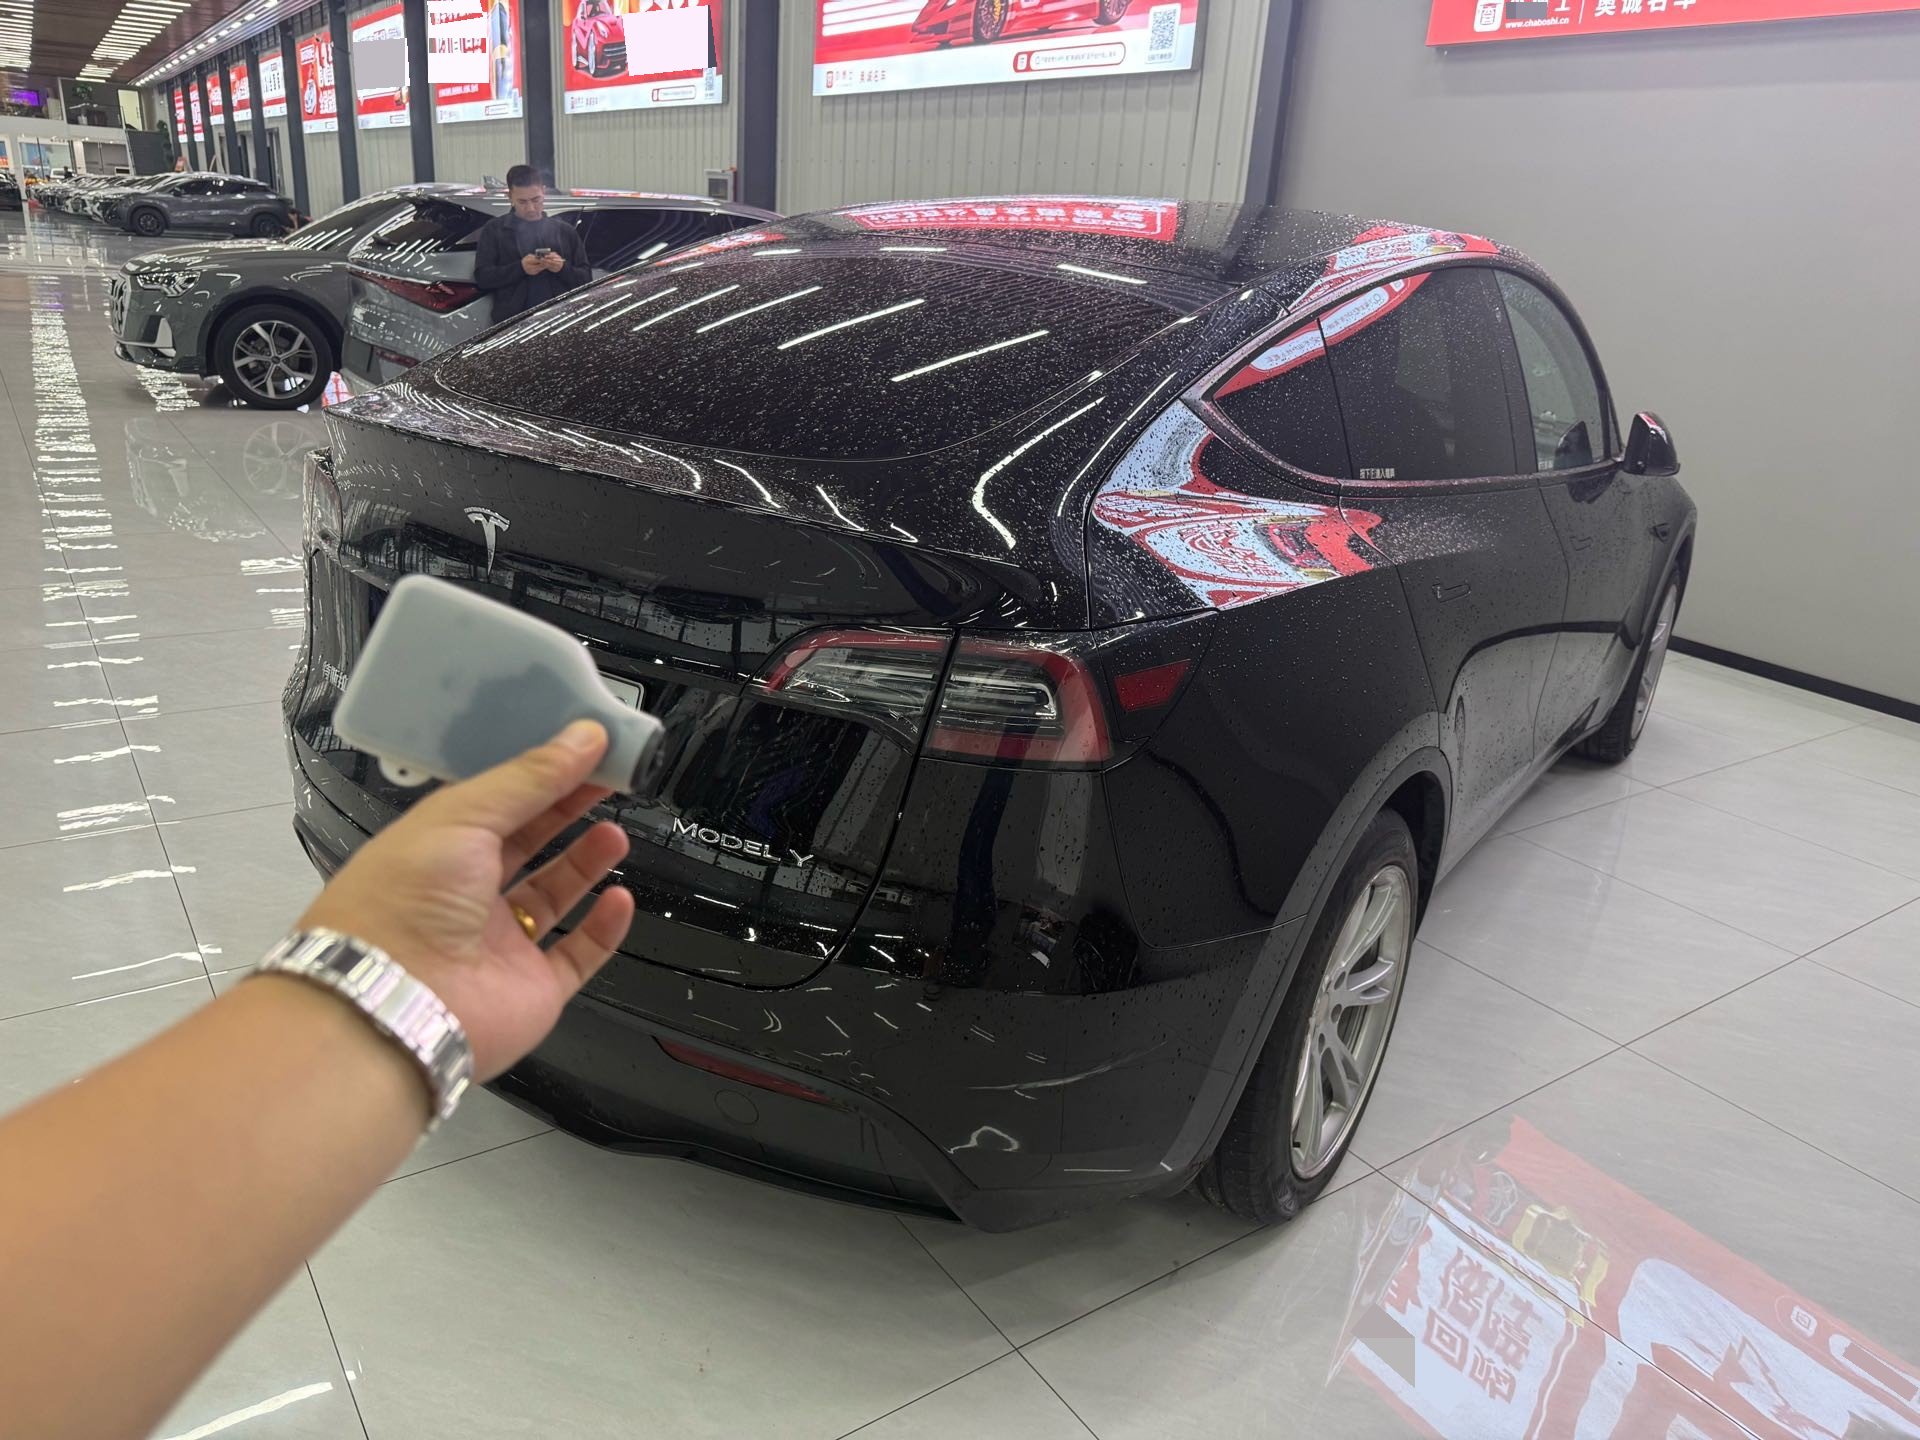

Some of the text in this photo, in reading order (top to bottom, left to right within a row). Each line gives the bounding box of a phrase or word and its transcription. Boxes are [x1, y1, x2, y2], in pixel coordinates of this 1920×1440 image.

[1505, 17, 1570, 29] www.chaboshi.cn
[673, 817, 814, 867] MODEL Y
